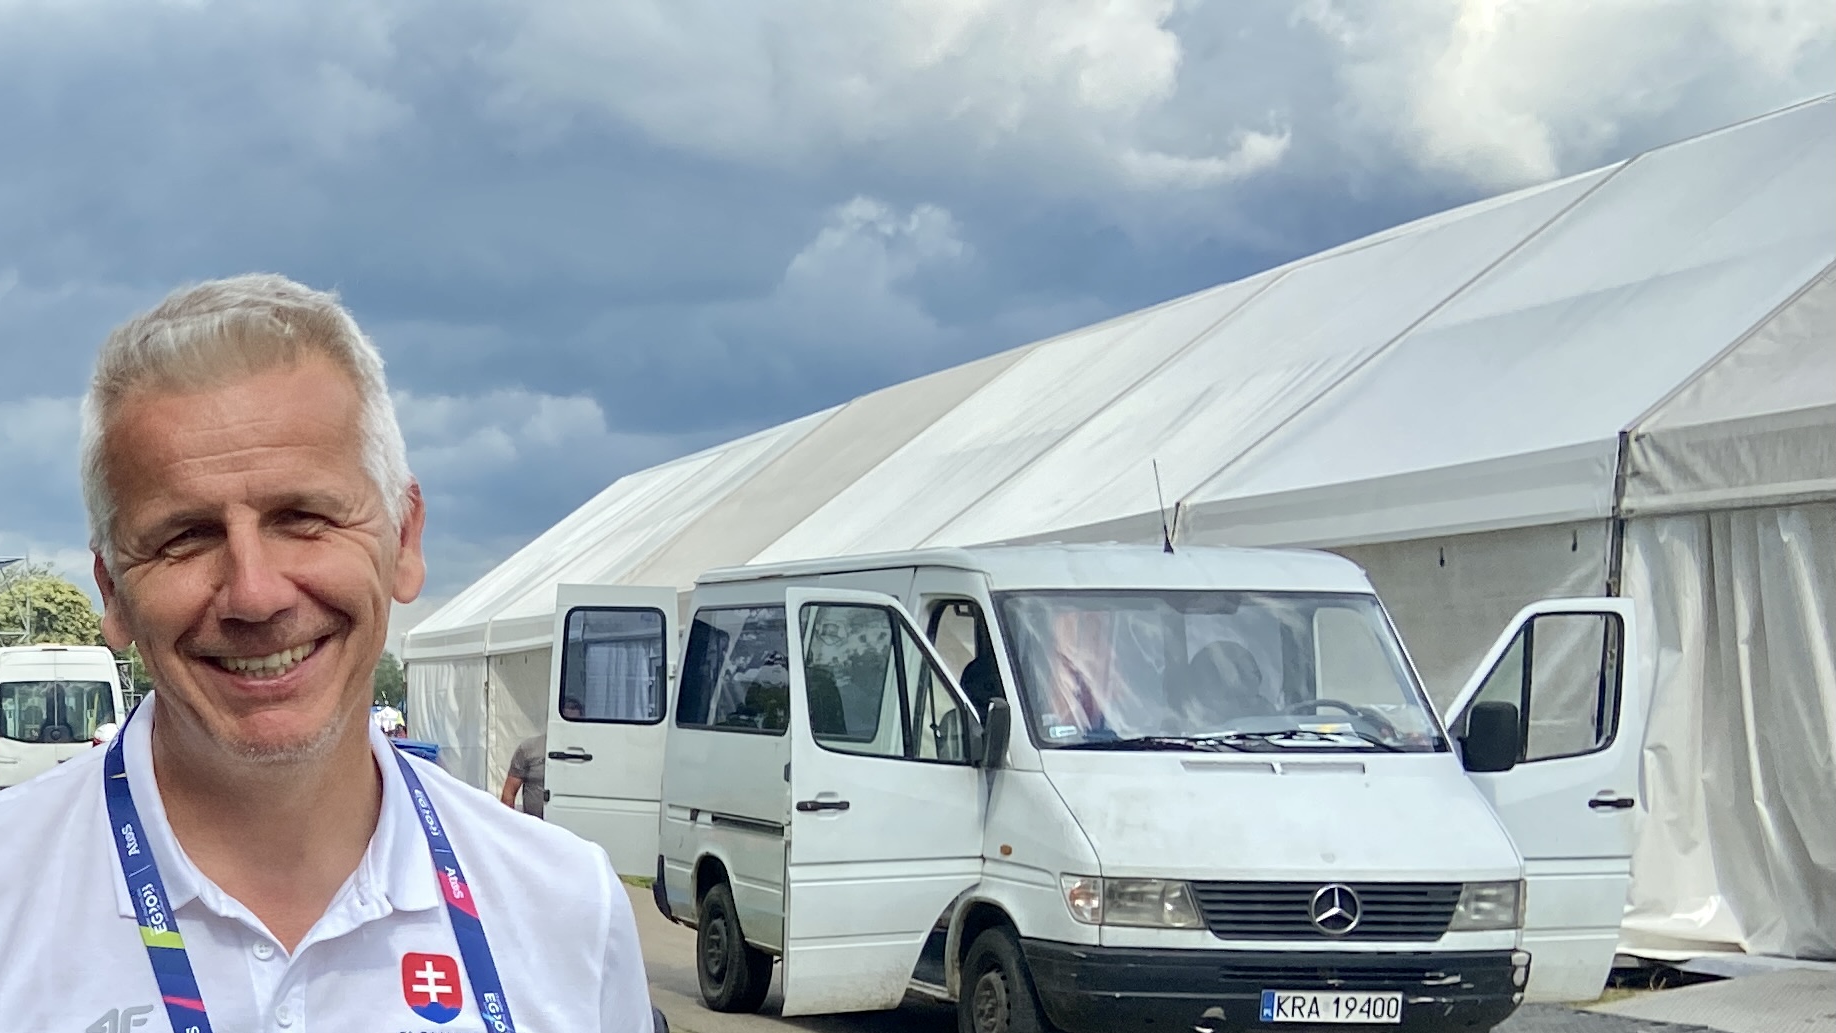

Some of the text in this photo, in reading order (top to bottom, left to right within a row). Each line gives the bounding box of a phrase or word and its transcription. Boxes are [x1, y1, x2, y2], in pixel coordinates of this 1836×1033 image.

[121, 823, 141, 857] Atos
[1276, 995, 1321, 1019] KRA
[1332, 996, 1400, 1019] 19400
